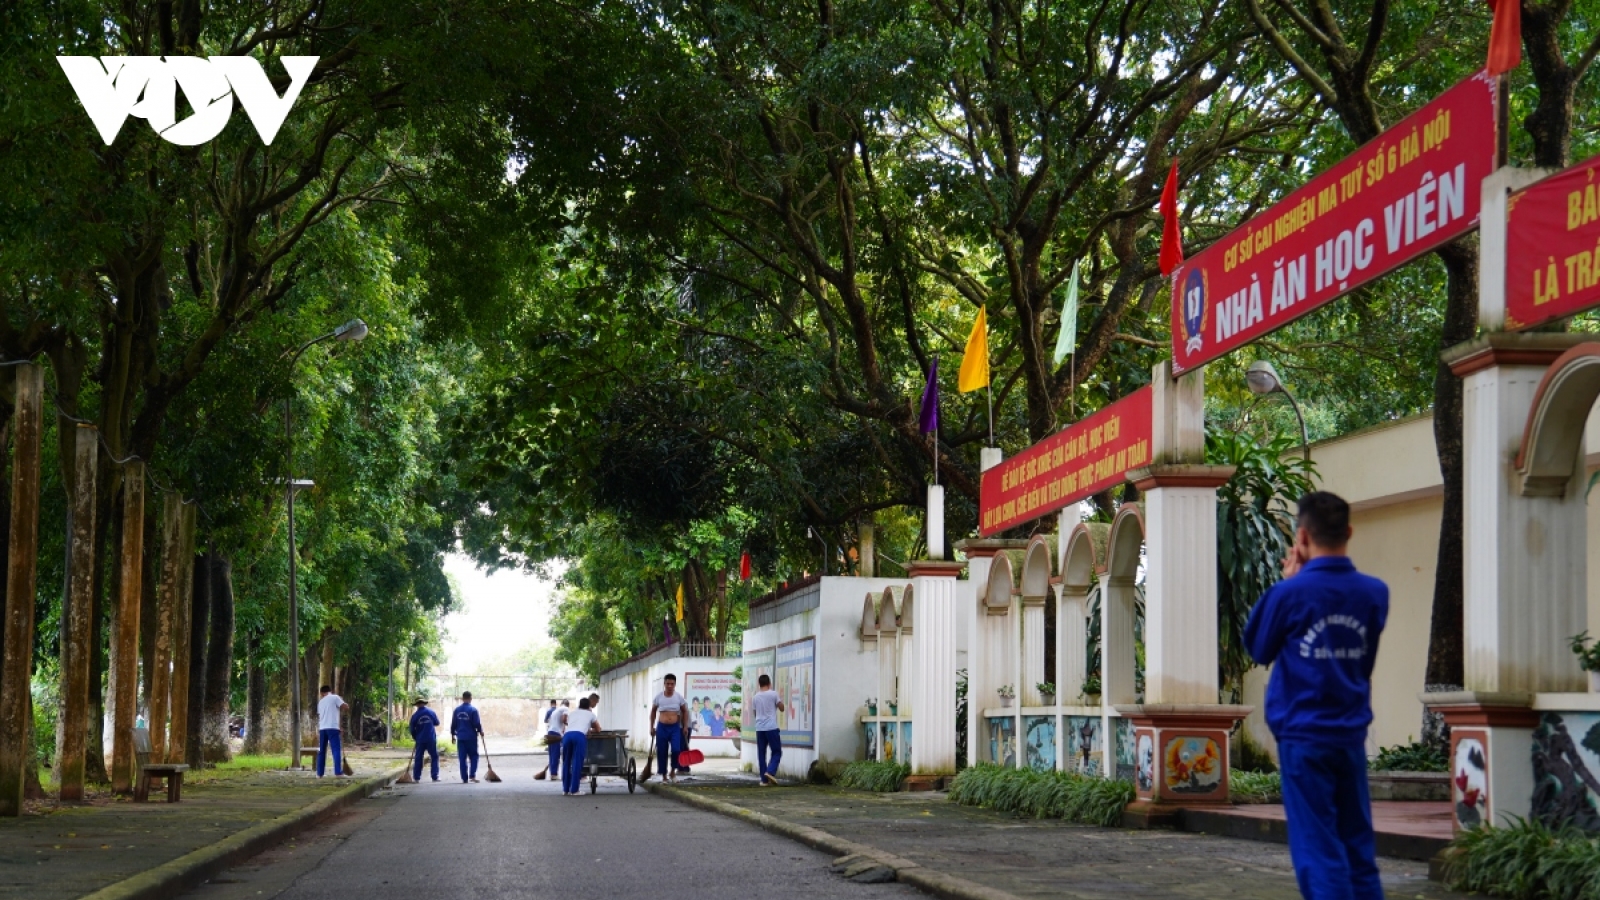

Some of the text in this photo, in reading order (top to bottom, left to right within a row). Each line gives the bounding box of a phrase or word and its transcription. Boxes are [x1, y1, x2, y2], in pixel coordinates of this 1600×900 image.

[1224, 109, 1450, 273] CƠ SỞ CAI NGHIỆN MA TUÝ SỐ 6 HÀ NỘI
[1567, 168, 1600, 231] BẢ
[1215, 163, 1465, 343] NHÀ ĂN HỌC VIÊN
[1533, 256, 1560, 306] LÀ
[1104, 415, 1120, 443] VIÊN
[1115, 449, 1126, 474] AN
[1127, 438, 1147, 468] TOÀN
